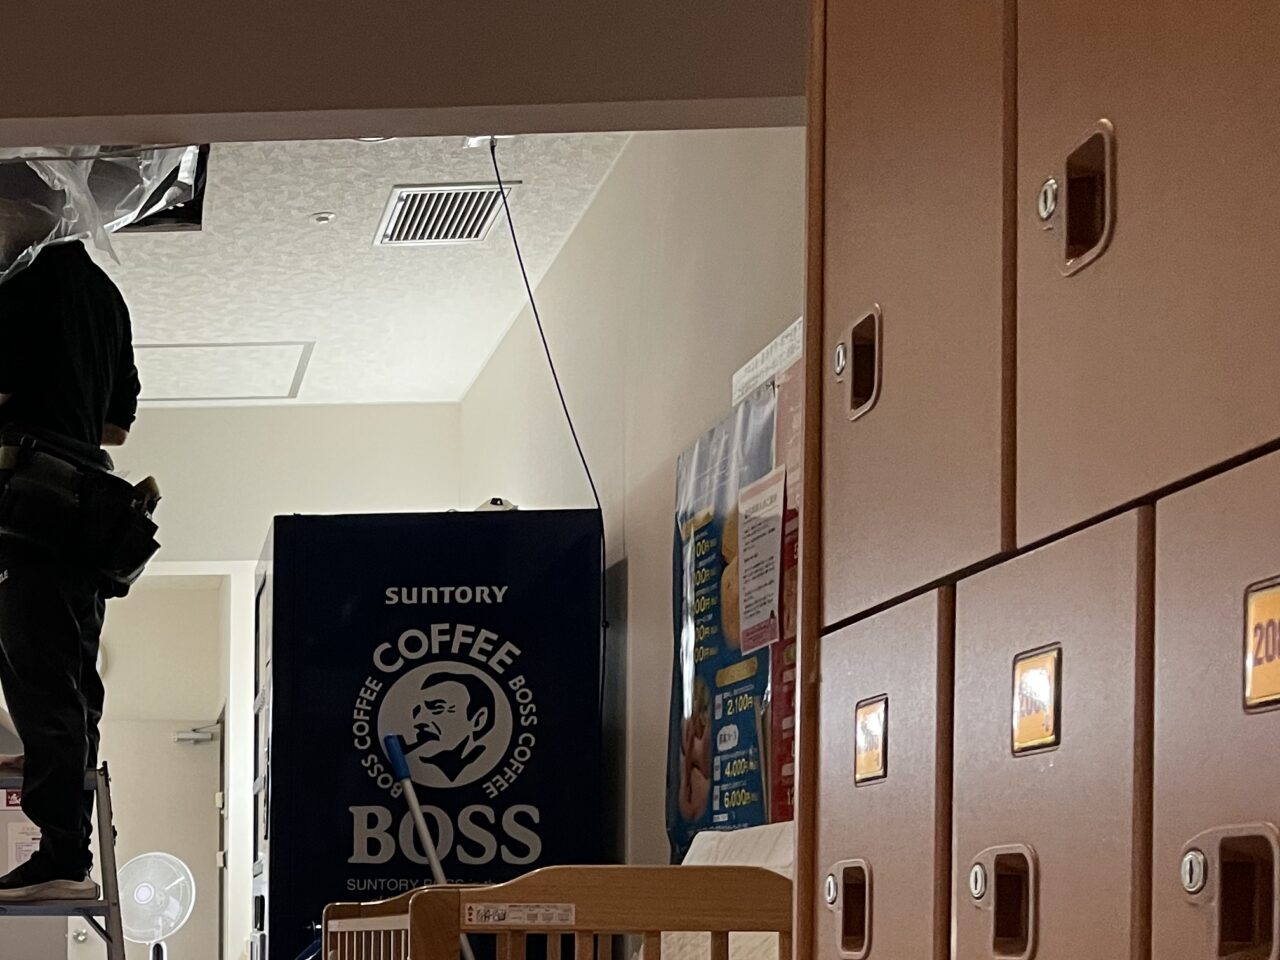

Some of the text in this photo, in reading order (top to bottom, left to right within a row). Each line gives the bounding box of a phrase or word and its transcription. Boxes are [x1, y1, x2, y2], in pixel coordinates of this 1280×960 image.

[385, 585, 509, 605] SUNTORY
[372, 622, 522, 675] COFFEE
[1254, 617, 1280, 667] 20
[352, 676, 383, 750] COFFEE
[481, 674, 538, 799] BOSS COFFEE
[347, 804, 543, 866] BOSS
[346, 878, 421, 891] SUNTORY
